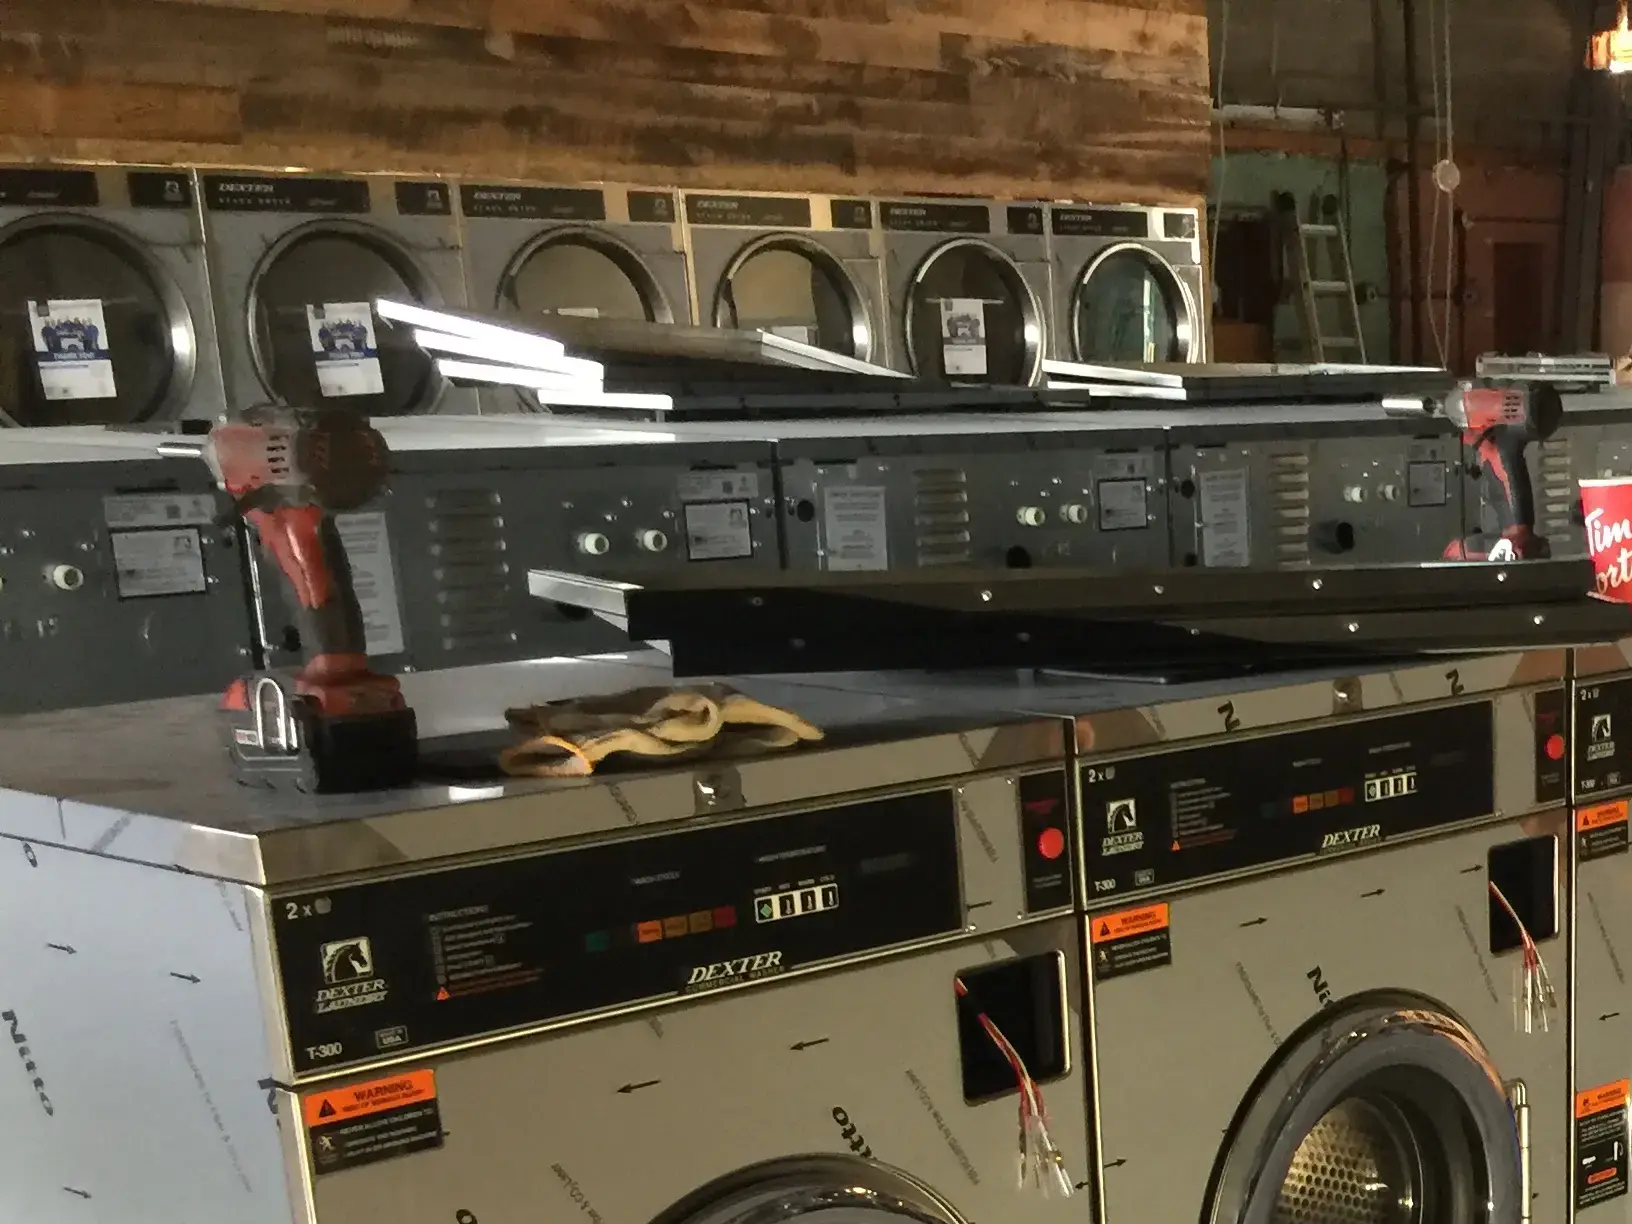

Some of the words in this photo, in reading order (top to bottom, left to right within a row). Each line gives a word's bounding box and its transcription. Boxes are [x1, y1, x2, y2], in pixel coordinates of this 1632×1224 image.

[1585, 507, 1632, 557] Tim
[1088, 768, 1097, 783] 2
[1102, 831, 1144, 847] DEXTER
[1321, 824, 1381, 848] DEXTER
[286, 902, 299, 920] 2
[687, 950, 783, 985] DEXTER
[316, 978, 388, 1001] DEXTER
[306, 1041, 343, 1061] T-300
[2, 1010, 53, 1116] Nitto
[353, 1078, 413, 1101] WARNING
[832, 1107, 876, 1160] itto
